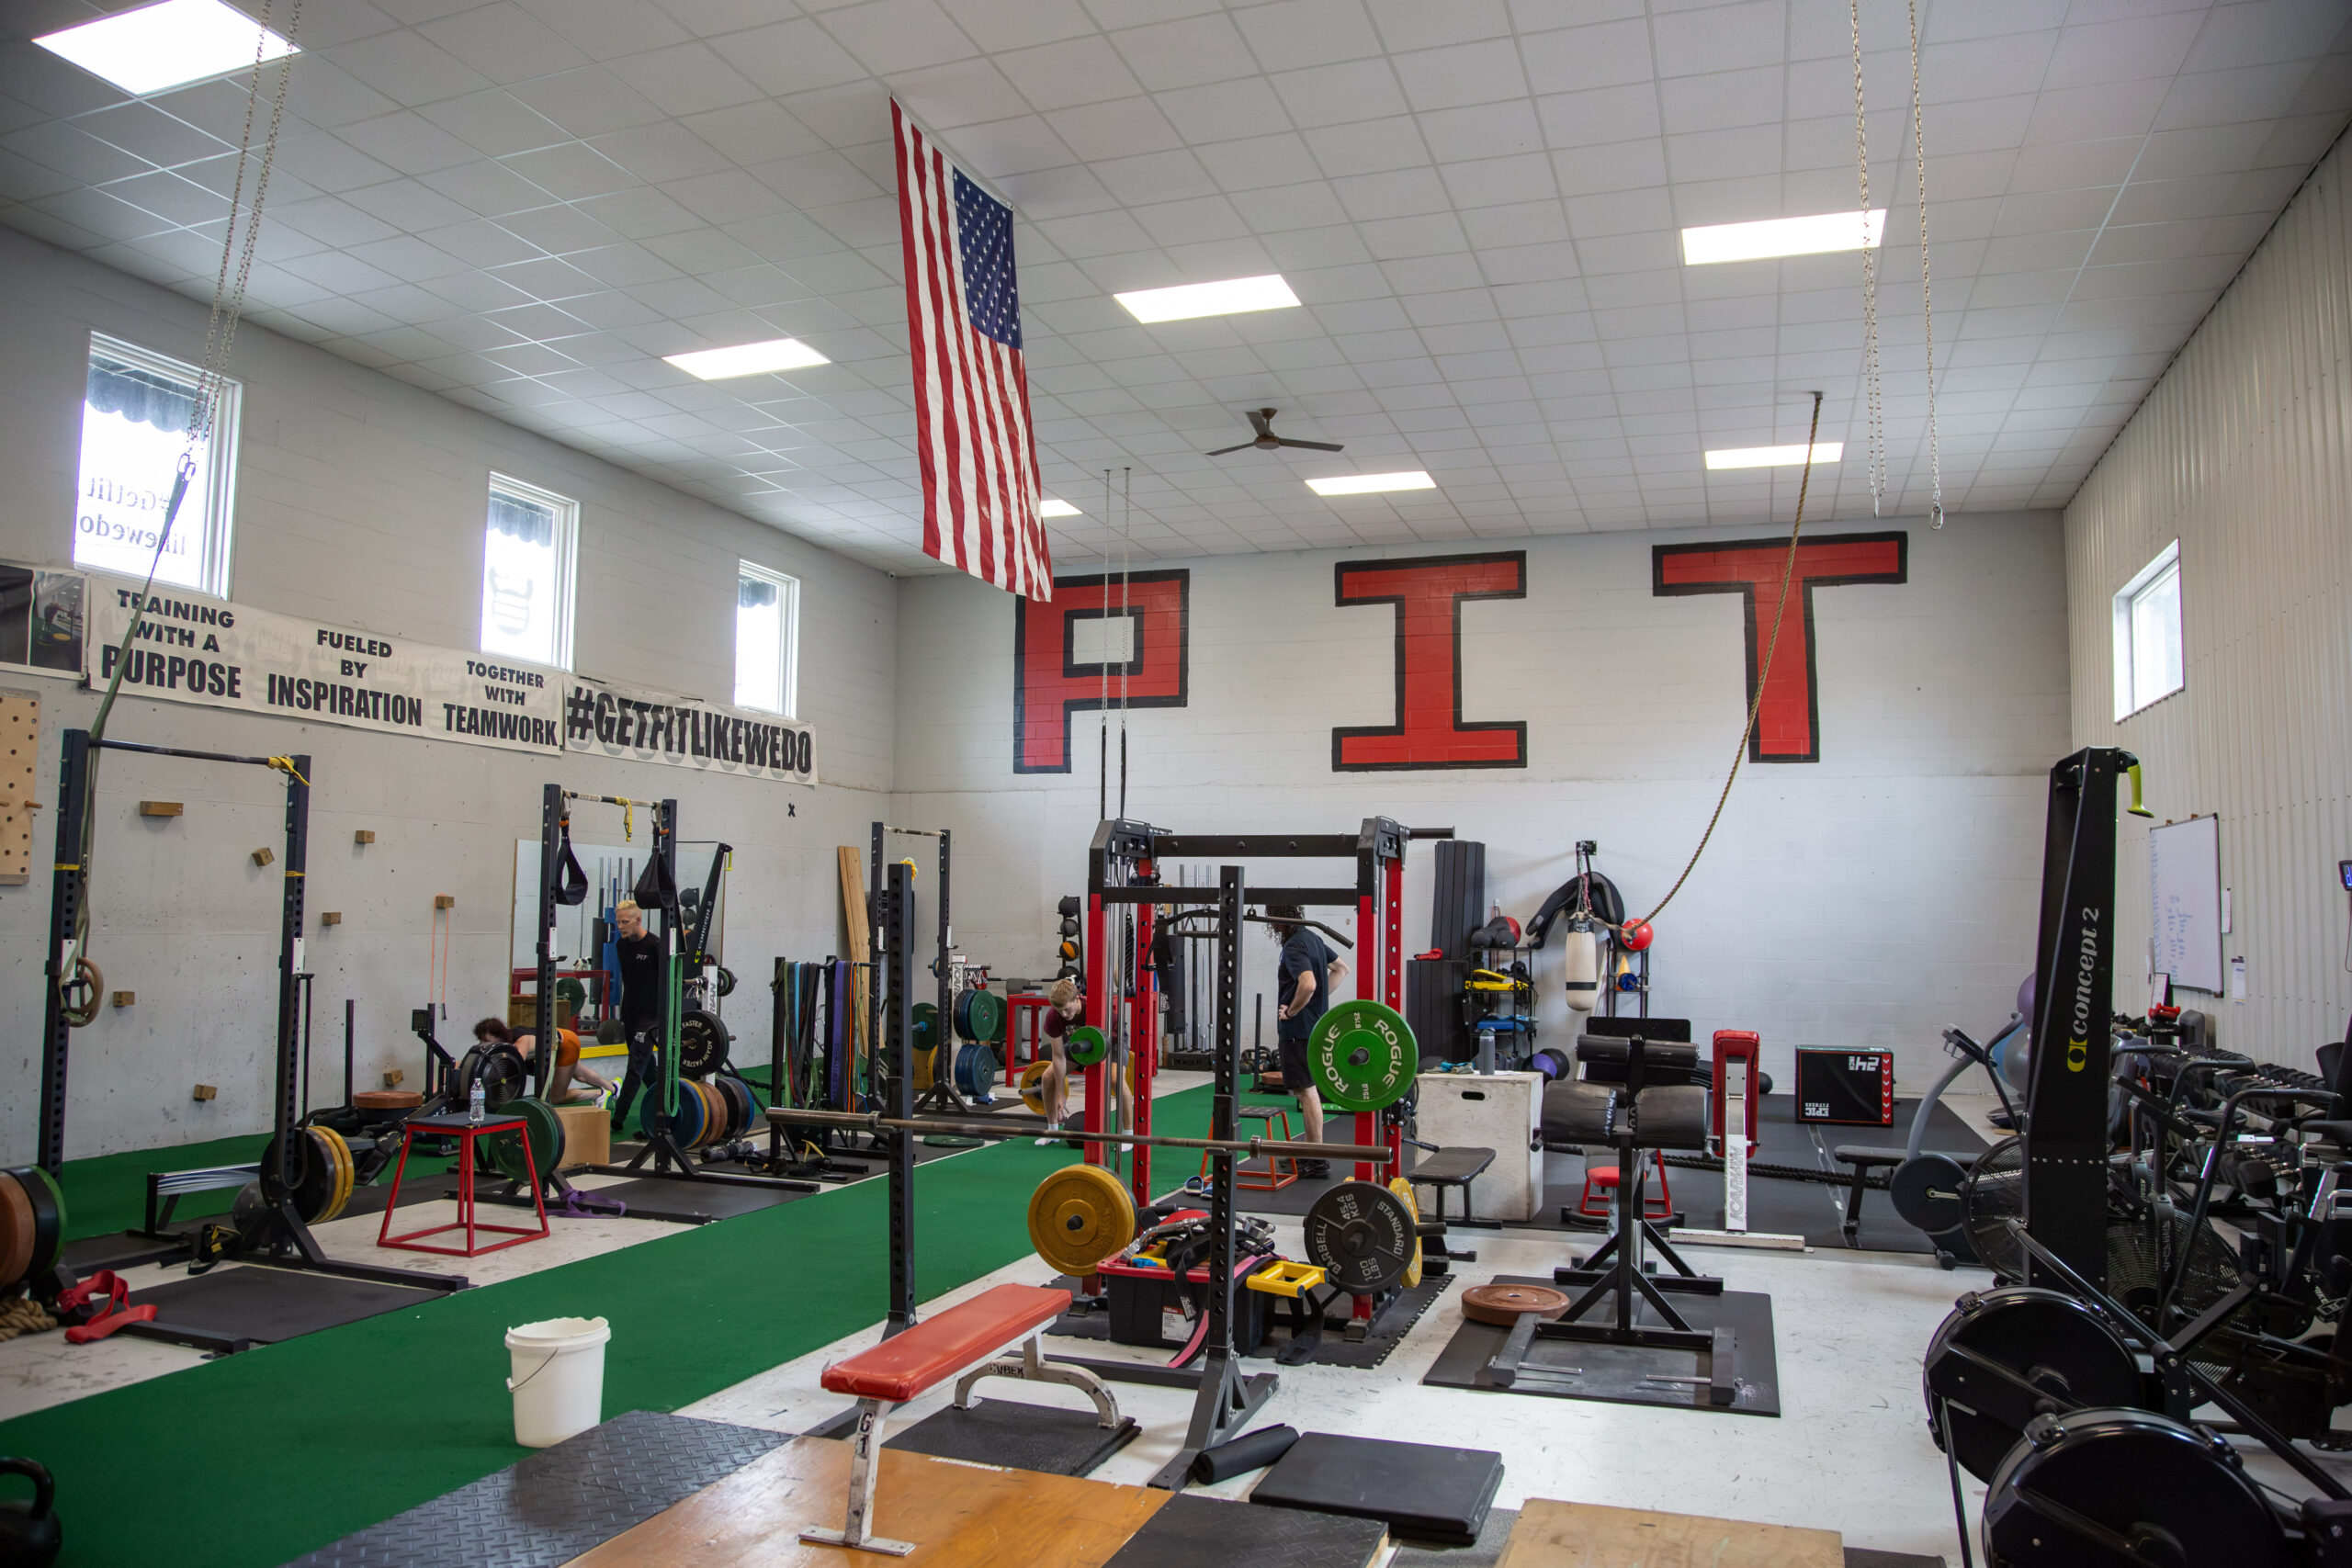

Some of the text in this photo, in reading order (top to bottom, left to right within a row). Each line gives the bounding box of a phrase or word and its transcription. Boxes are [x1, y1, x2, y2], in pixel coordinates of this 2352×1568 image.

[117, 589, 235, 628] TRAINING
[202, 634, 220, 653] A
[317, 629, 392, 658] FUELED
[1012, 530, 1907, 773] PIT
[101, 644, 242, 699] PURPOSE
[340, 659, 368, 679] BY
[466, 660, 545, 688] TOGETHER
[267, 673, 422, 727] INSPIRATION
[484, 684, 526, 706] WITH
[443, 703, 558, 746] TEAMWORK
[566, 686, 812, 773] #GETFITLIKEWEDO
[2073, 907, 2099, 1036] concept 2
[682, 1020, 703, 1029] FASTER
[1321, 1024, 1349, 1093] ROGUE
[1374, 1019, 1402, 1089] ROGUE
[1855, 1056, 1880, 1071] 24
[1804, 1108, 1829, 1117] EPIC
[1345, 1193, 1360, 1218] KGS
[1377, 1201, 1405, 1256] STANDARD
[1316, 1223, 1342, 1274] BARBELL
[1360, 1260, 1374, 1282] 100
[1369, 1258, 1382, 1280] LBS
